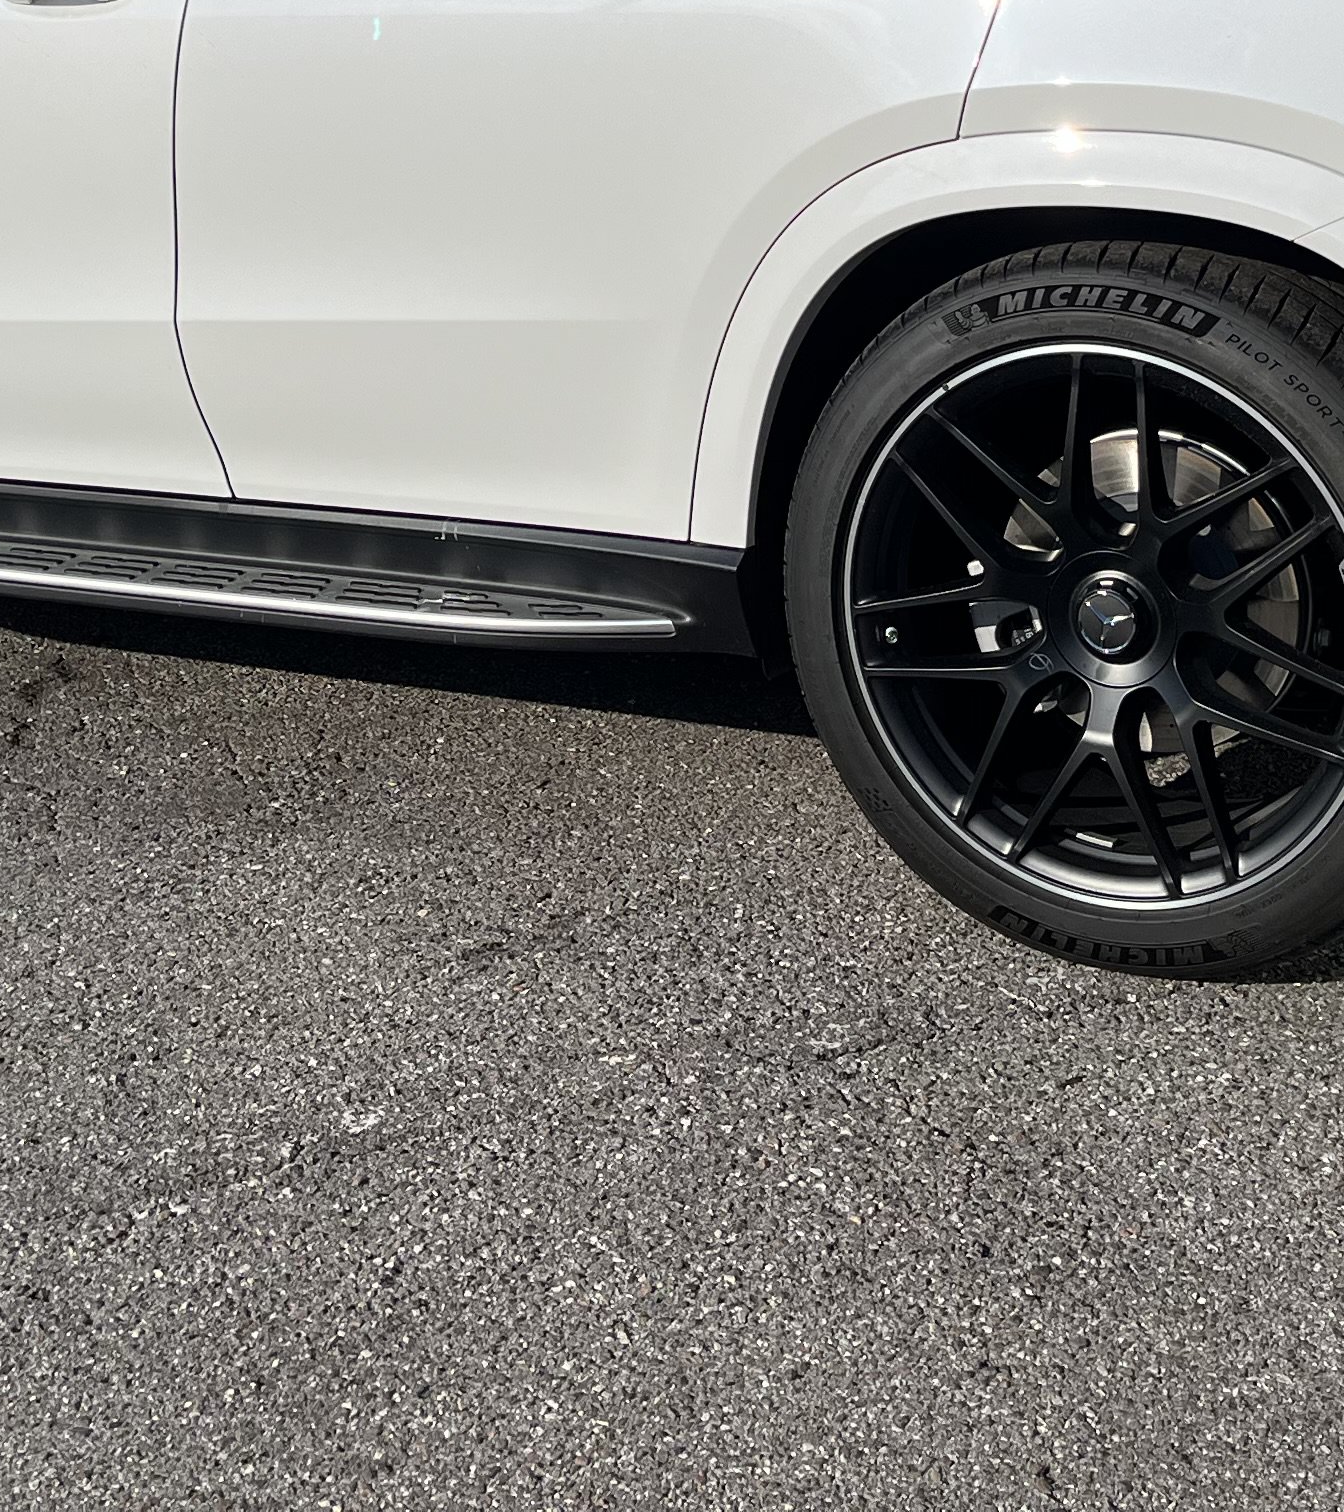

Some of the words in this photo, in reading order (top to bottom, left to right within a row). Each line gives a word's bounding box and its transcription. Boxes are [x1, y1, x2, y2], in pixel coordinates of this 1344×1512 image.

[996, 286, 1207, 330] MICHELIN
[1225, 333, 1284, 371] PILOT
[1283, 374, 1344, 428] SPORT
[999, 913, 1206, 966] MICHELIN
